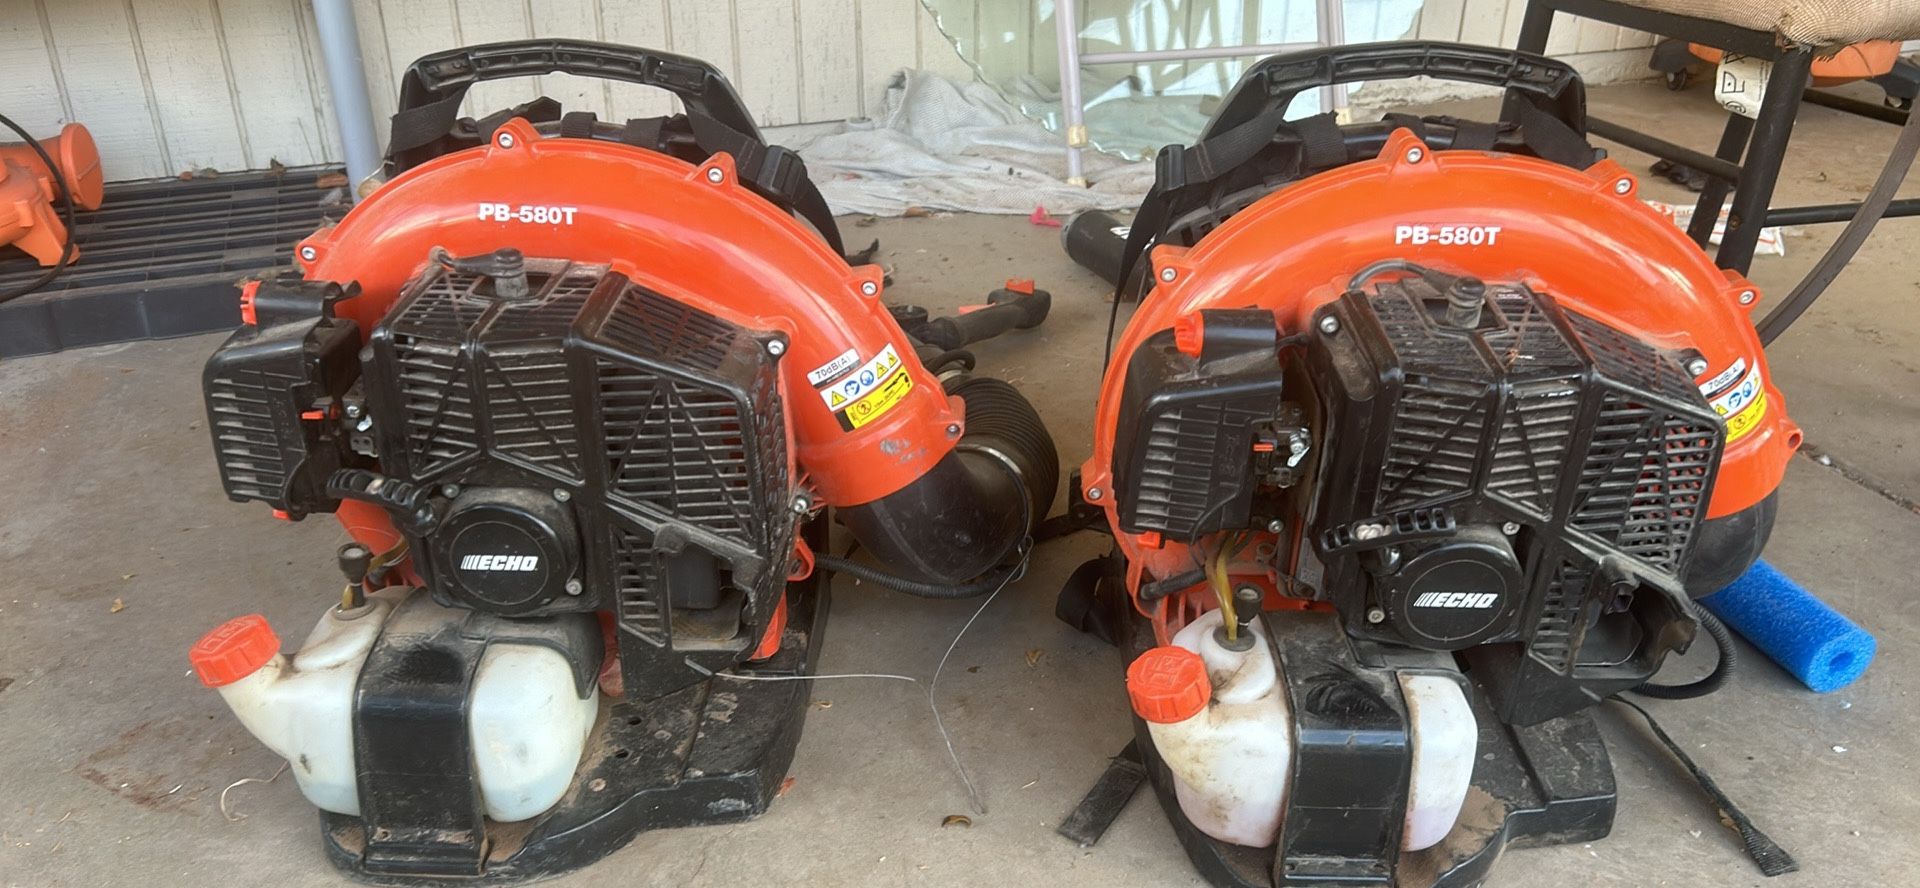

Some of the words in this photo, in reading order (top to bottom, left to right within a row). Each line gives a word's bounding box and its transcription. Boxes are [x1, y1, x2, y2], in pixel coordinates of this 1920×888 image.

[479, 203, 578, 225] PB-580T
[1395, 225, 1501, 246] PB-580T
[815, 355, 851, 380] 70dB(A)
[477, 555, 539, 571] ECHO
[1430, 592, 1498, 609] ECHO
